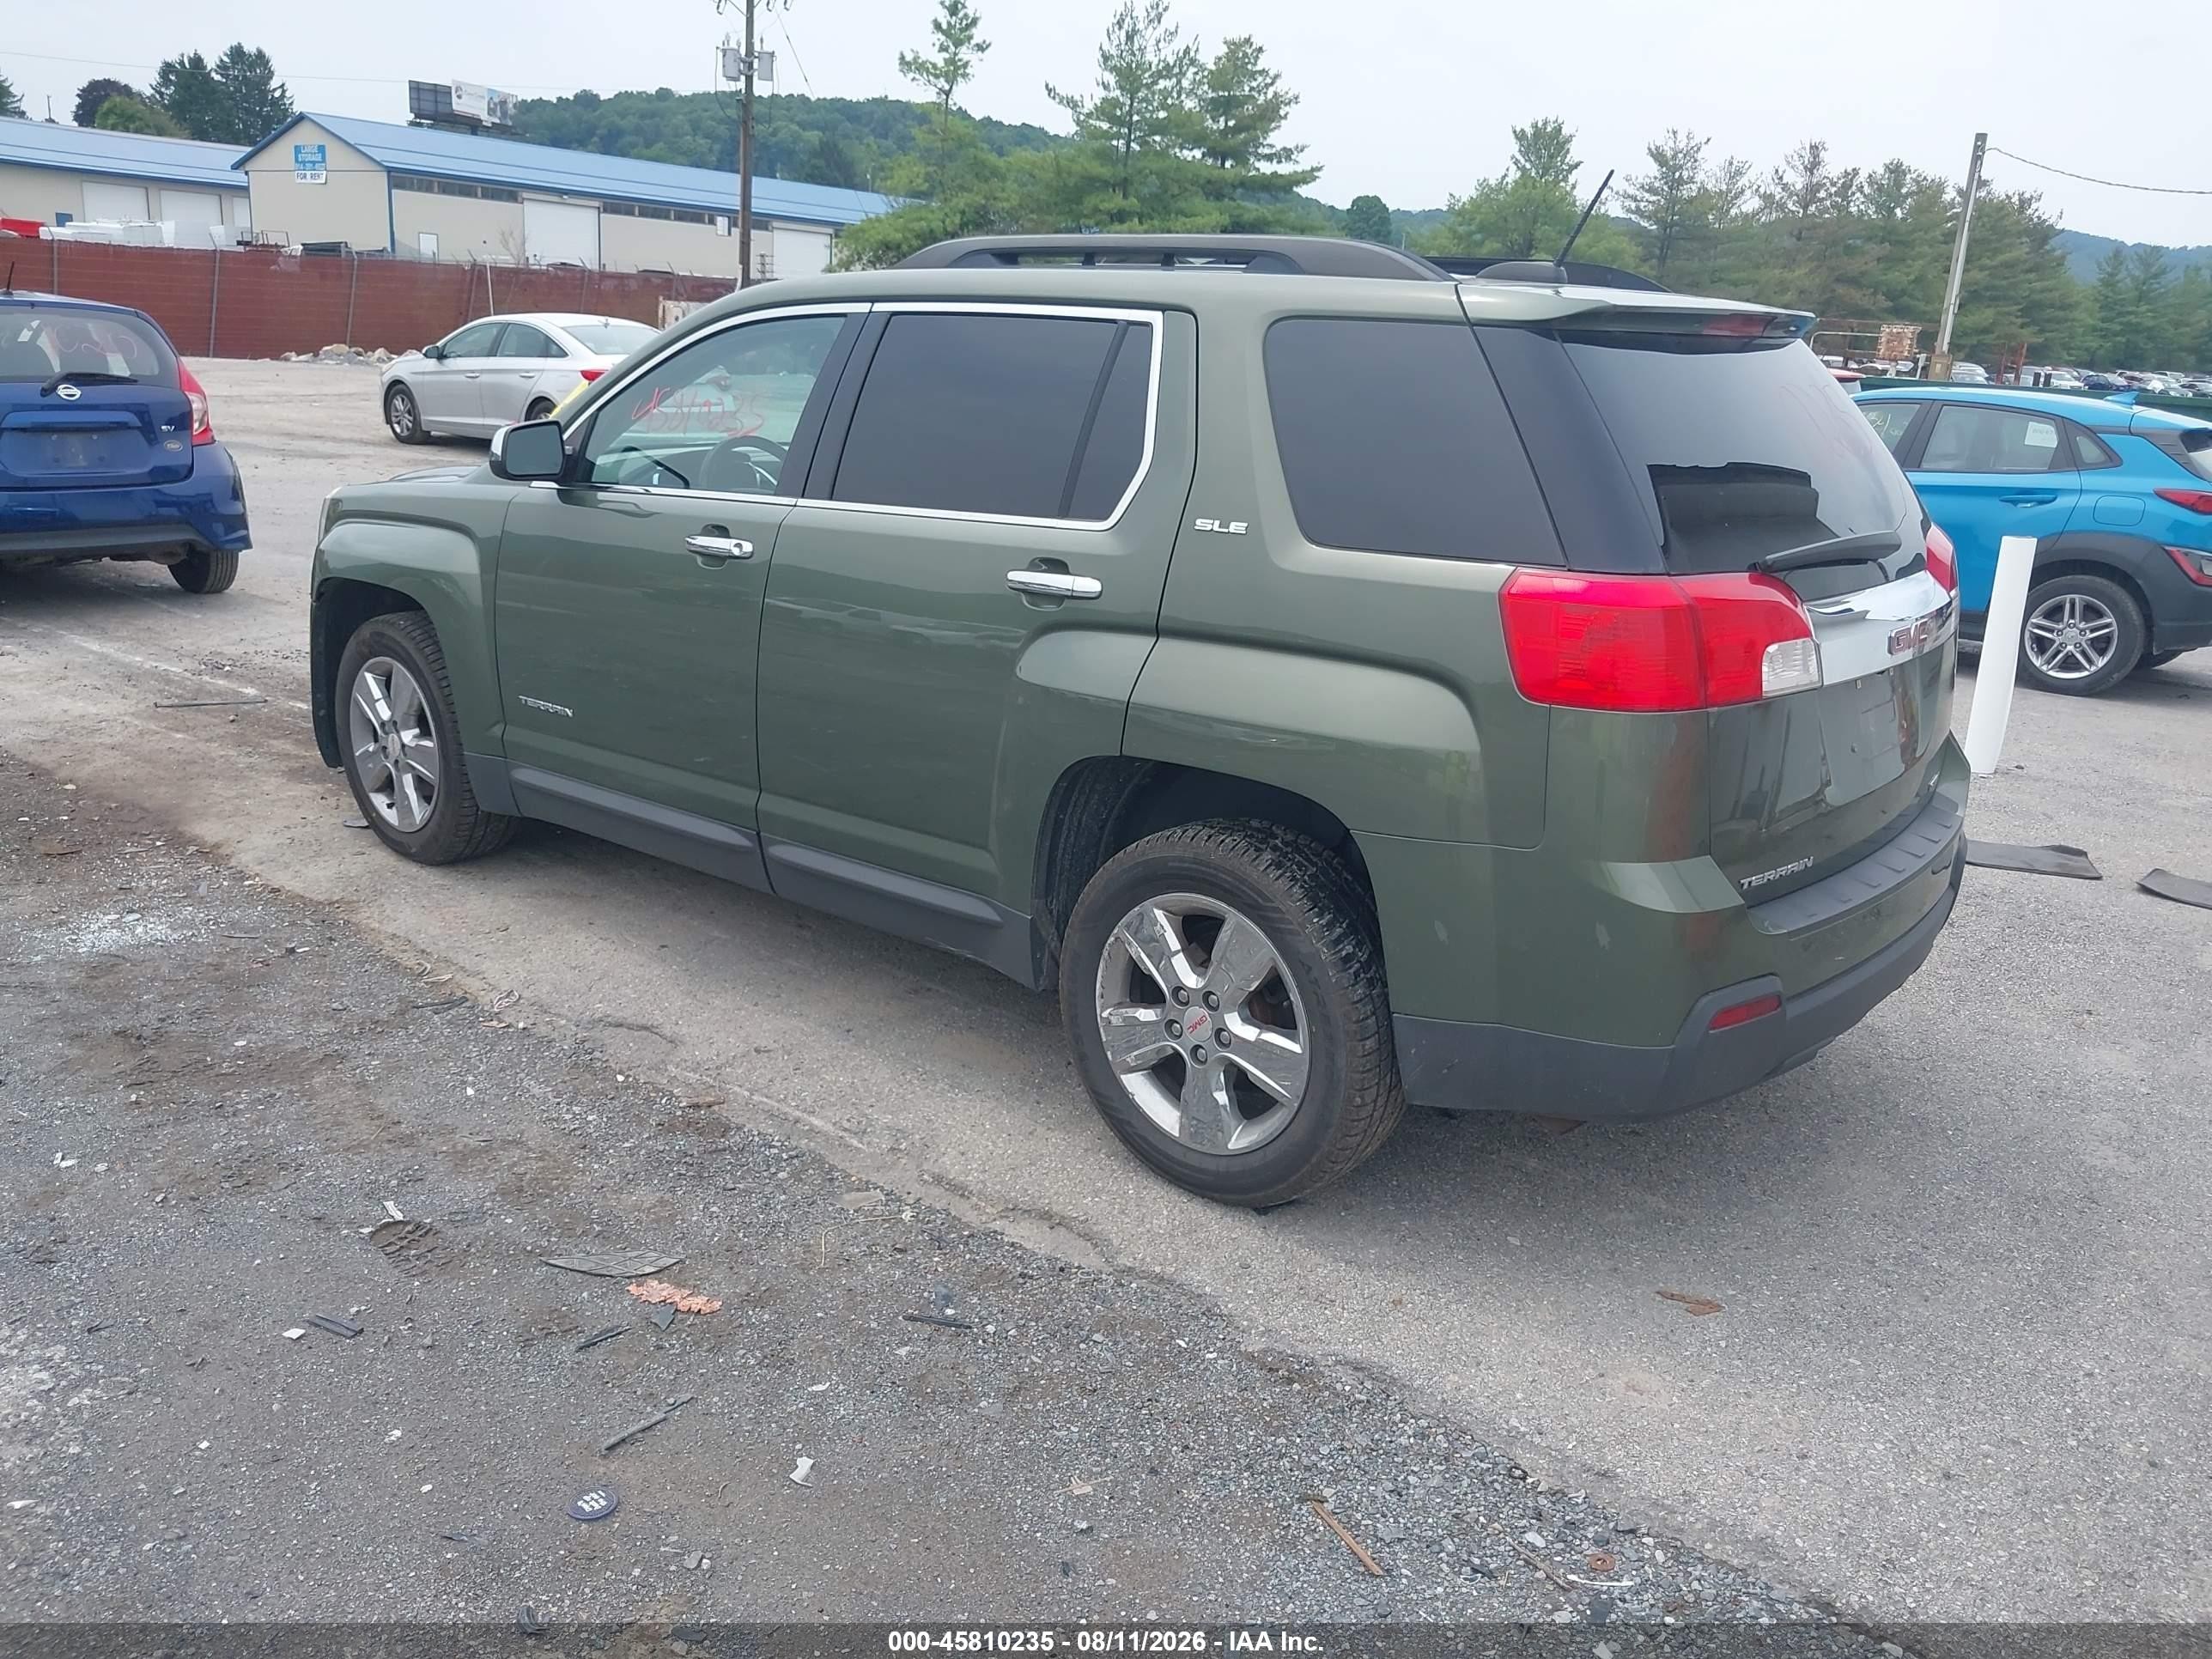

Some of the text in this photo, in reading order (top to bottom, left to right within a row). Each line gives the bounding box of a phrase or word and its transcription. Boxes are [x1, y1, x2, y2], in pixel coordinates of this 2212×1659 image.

[310, 172, 324, 180] RENT
[1194, 518, 1249, 534] SLE
[1889, 617, 1929, 654] GMC
[1739, 856, 1814, 890] TERRAIN
[1187, 1014, 1208, 1035] GMC
